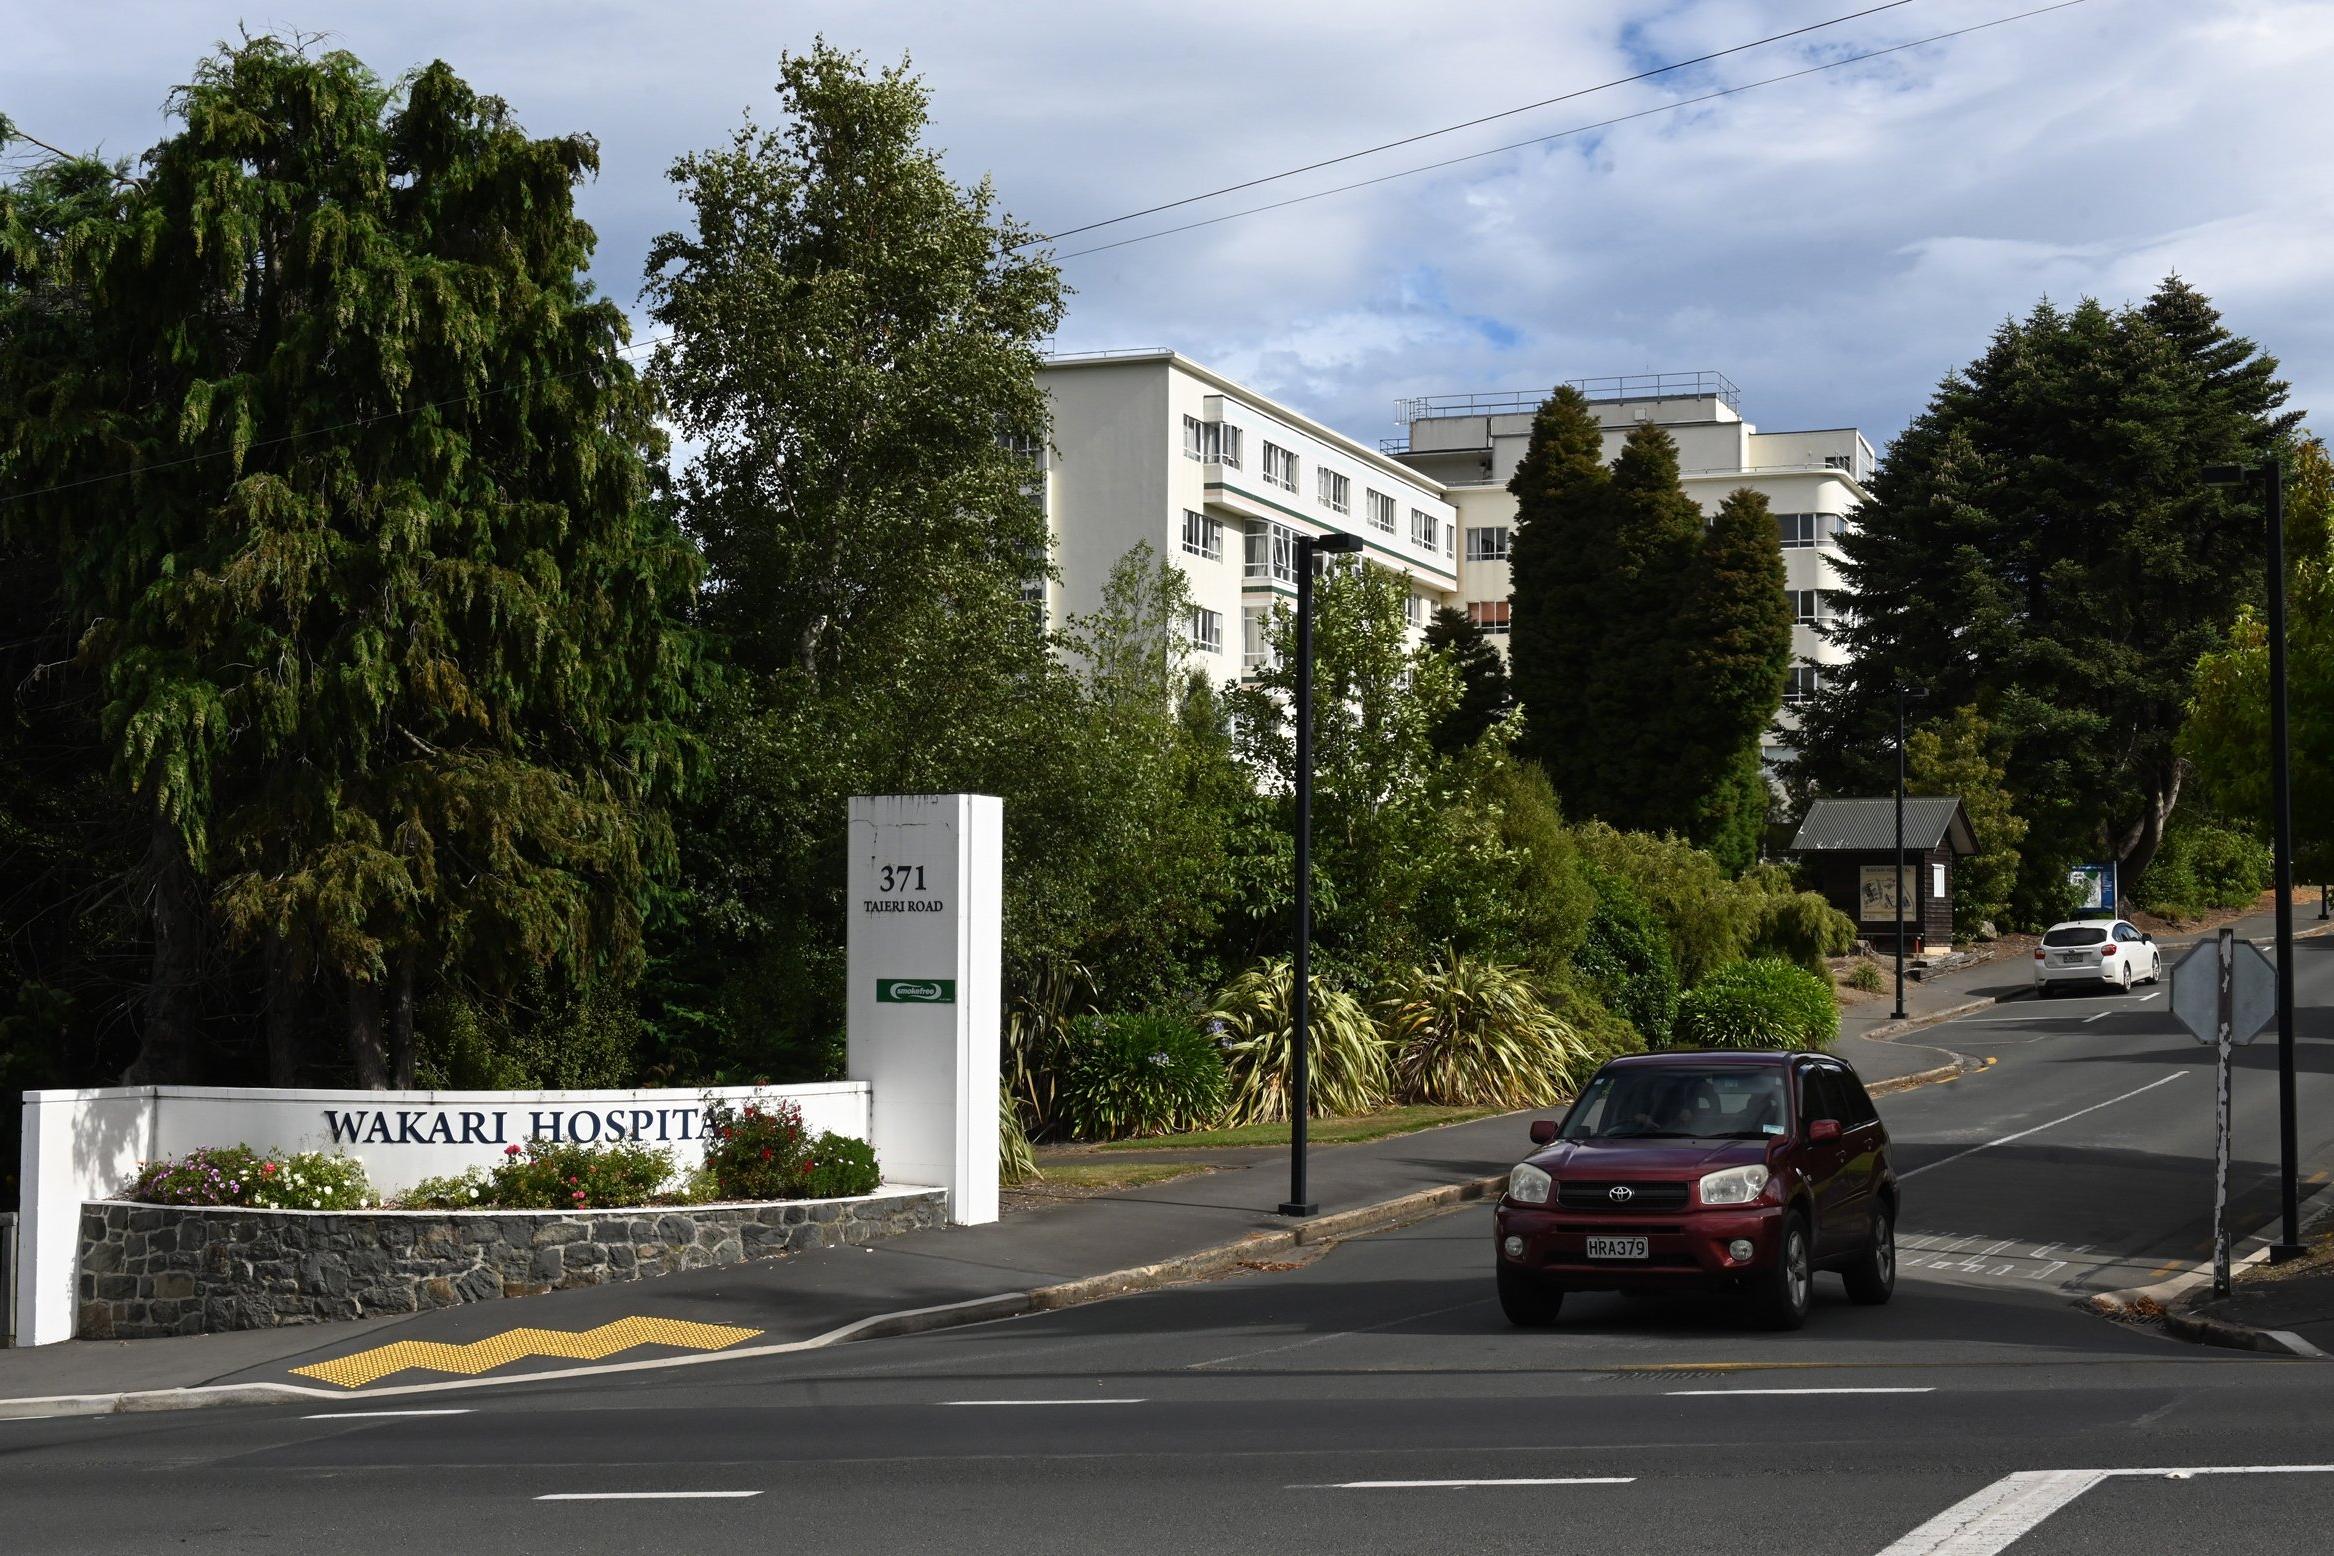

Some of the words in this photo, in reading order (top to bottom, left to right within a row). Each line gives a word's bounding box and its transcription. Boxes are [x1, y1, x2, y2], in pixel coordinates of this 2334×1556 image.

[880, 865, 927, 892] 371
[864, 900, 905, 913] TAIERI
[908, 900, 943, 912] ROAD
[896, 987, 935, 995] smokefree
[324, 1110, 508, 1144] WAKARI
[528, 1107, 737, 1144] HOSPITA
[1589, 1240, 1645, 1256] HRA379
